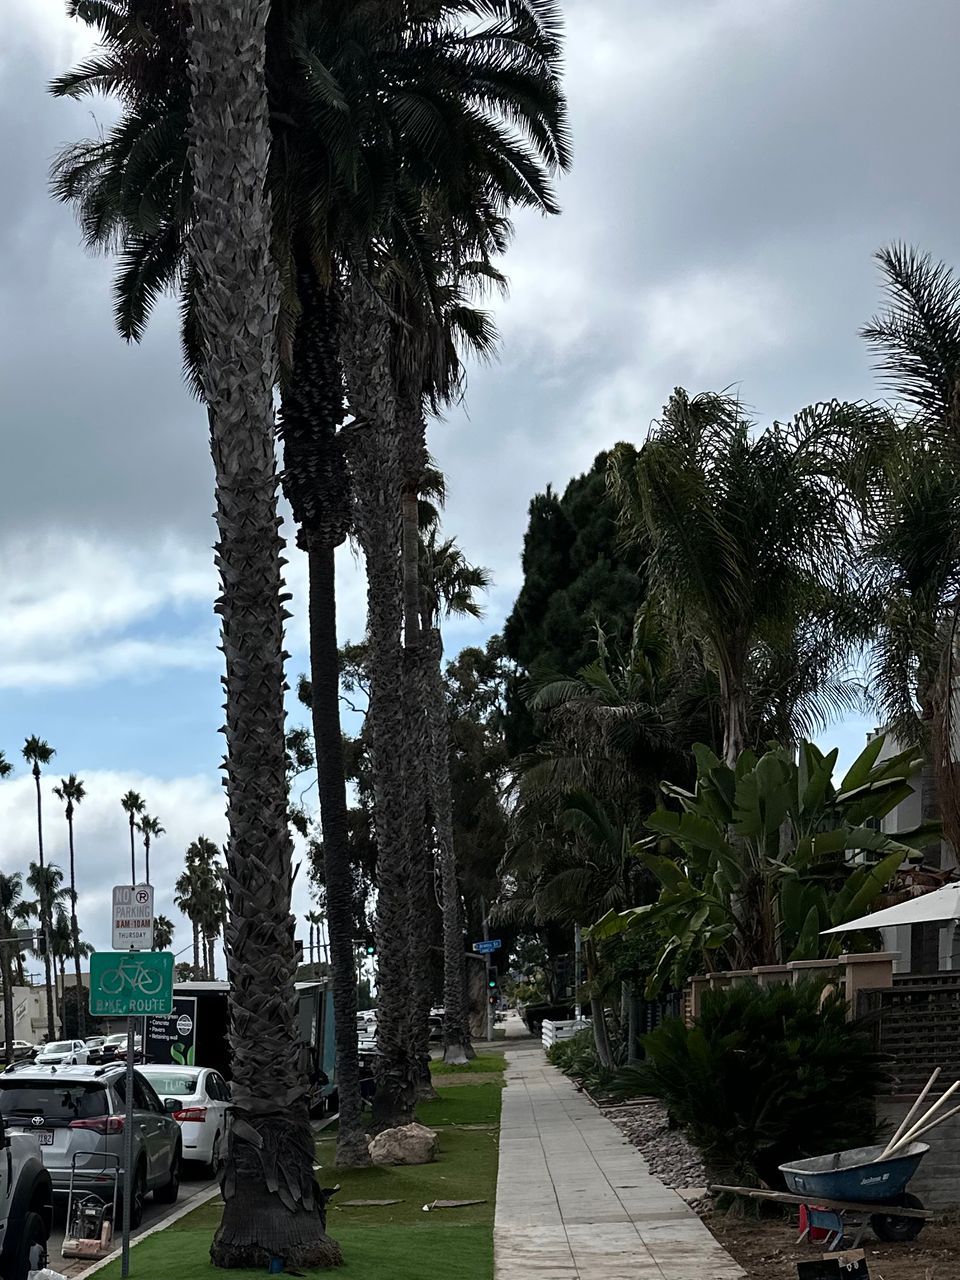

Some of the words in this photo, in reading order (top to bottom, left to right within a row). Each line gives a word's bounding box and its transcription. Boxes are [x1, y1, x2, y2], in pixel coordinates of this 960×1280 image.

[115, 888, 130, 904] NO
[116, 905, 150, 918] PARKING
[95, 999, 122, 1011] BIKE
[129, 998, 166, 1012] ROUTE
